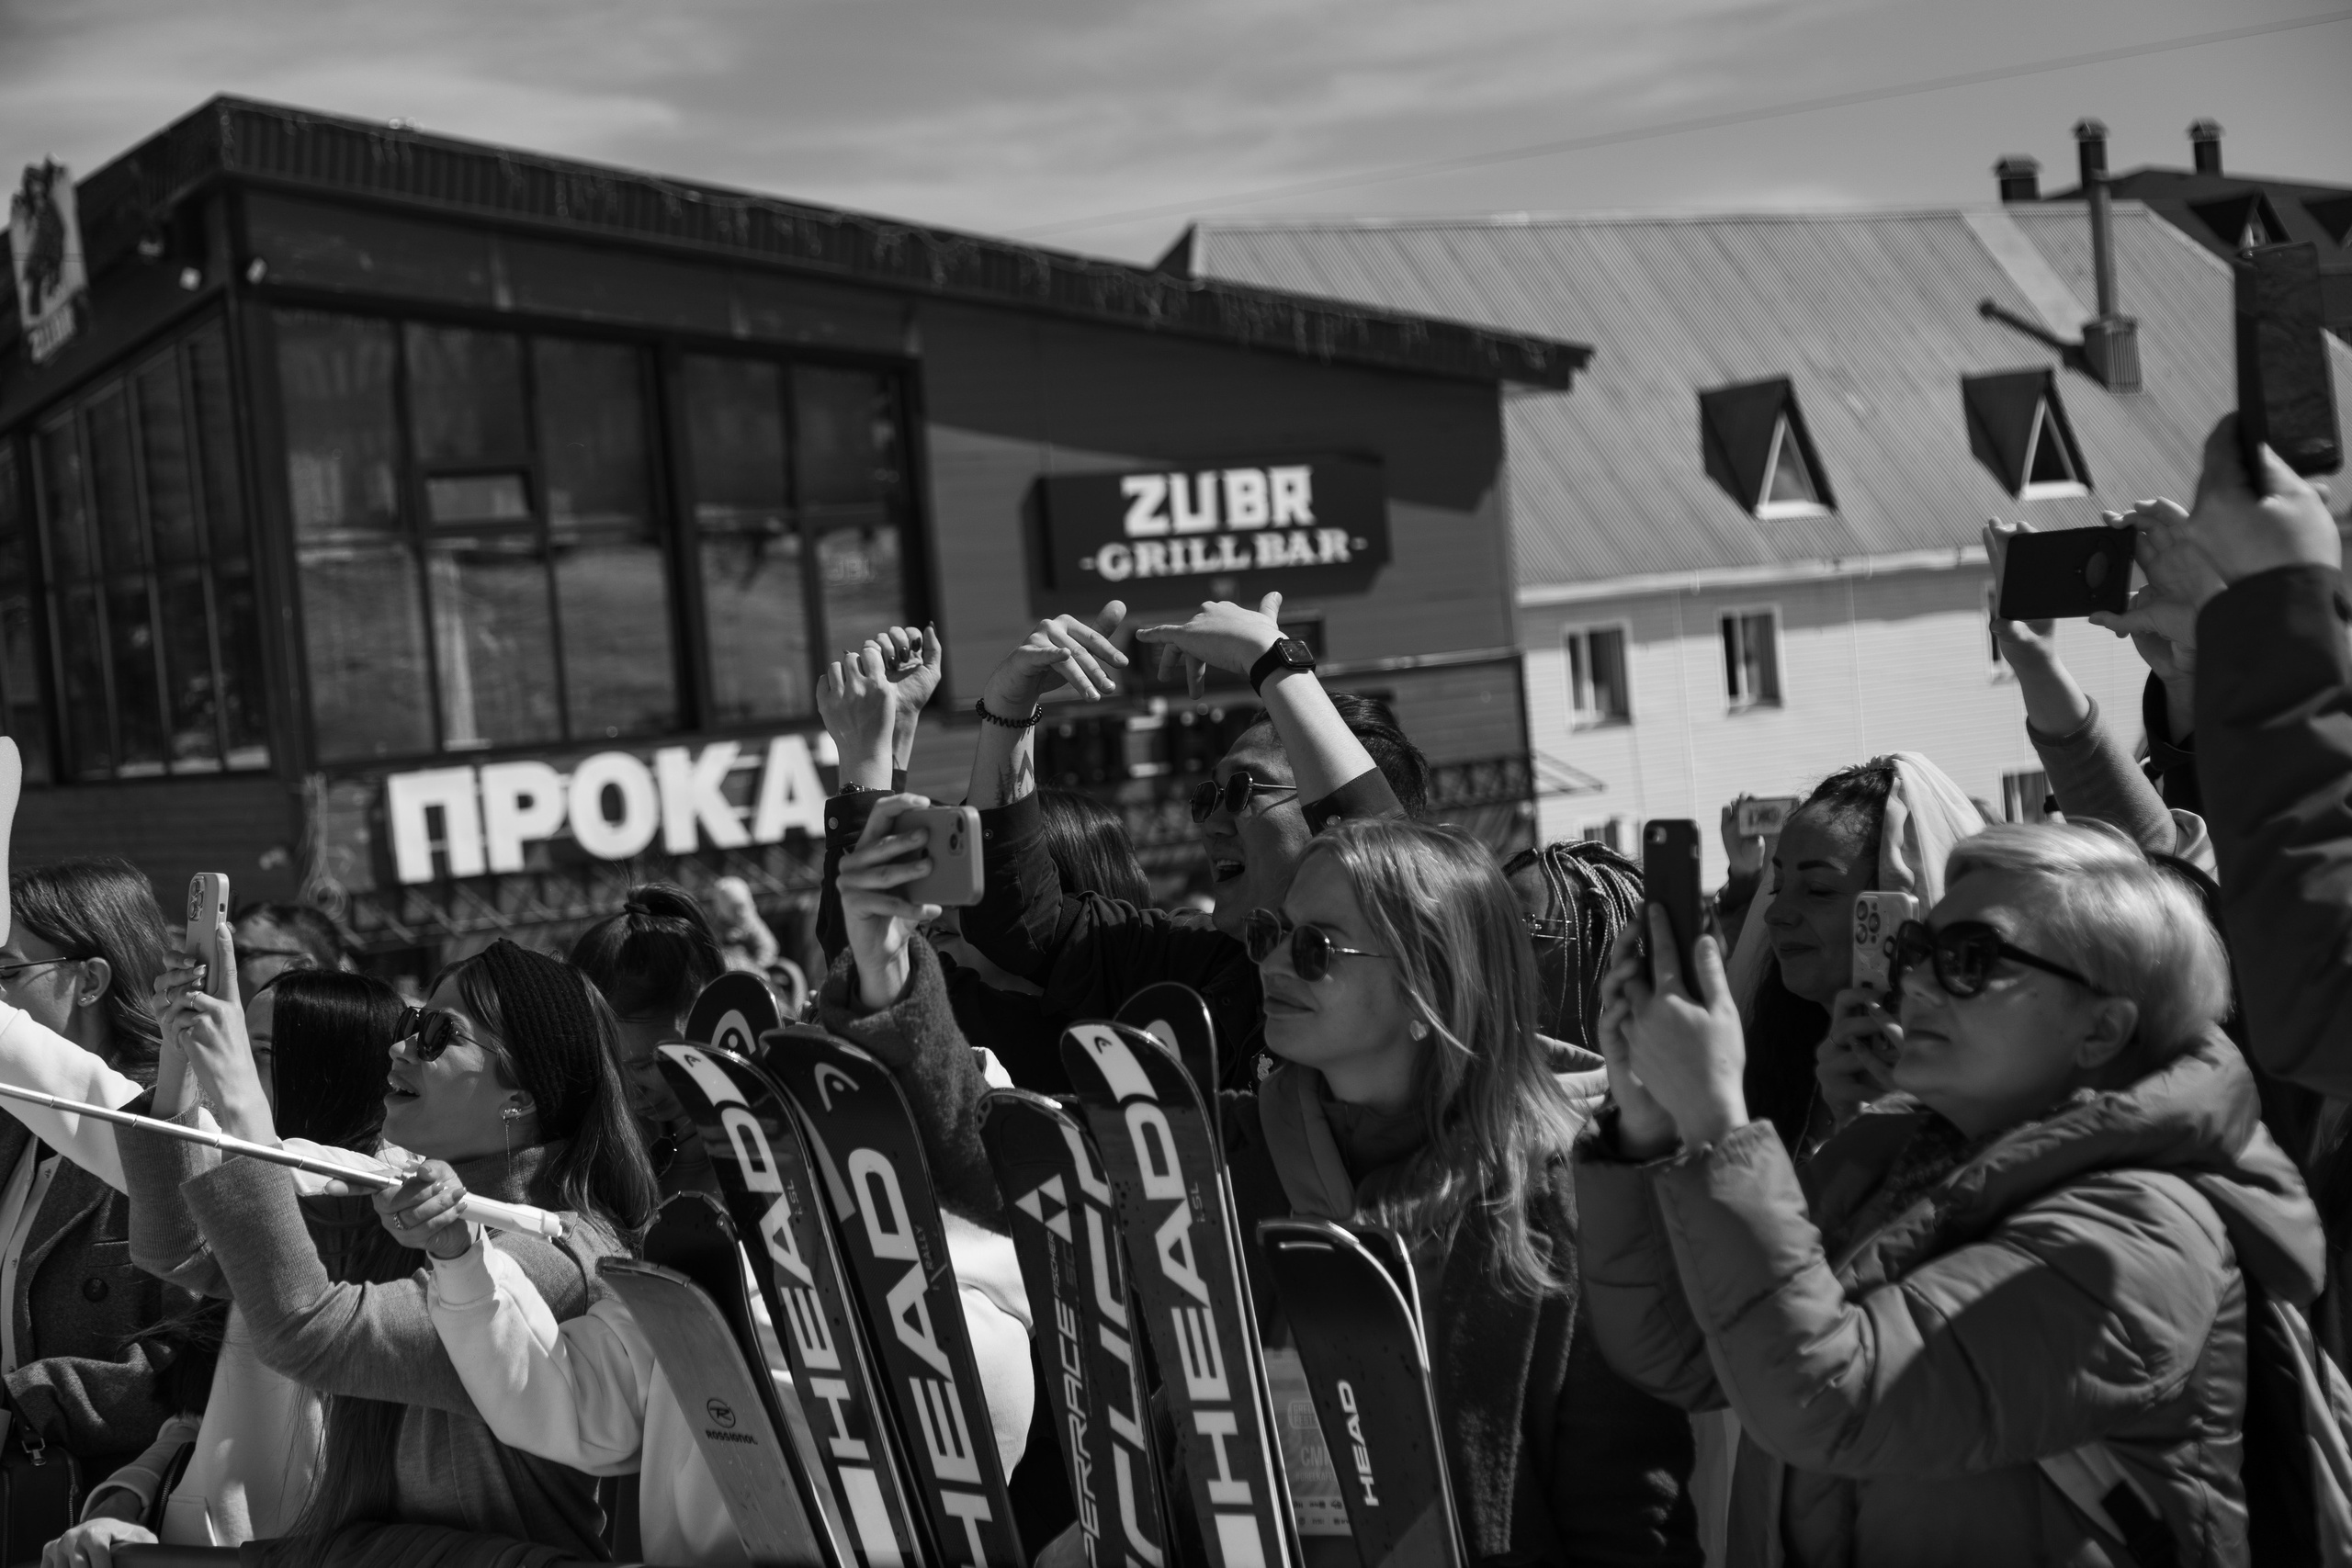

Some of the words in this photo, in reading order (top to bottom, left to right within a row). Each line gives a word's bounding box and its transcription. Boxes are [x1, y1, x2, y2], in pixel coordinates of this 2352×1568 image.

[1120, 464, 1317, 538] ZUBR
[387, 730, 840, 886] ПРОКА
[721, 1108, 870, 1461] HEAD
[1047, 1230, 1061, 1298] FISCHER
[1125, 1102, 1253, 1505] HEAD
[706, 1429, 758, 1445] ROSSIGNOL
[1337, 1379, 1379, 1506] HEAD
